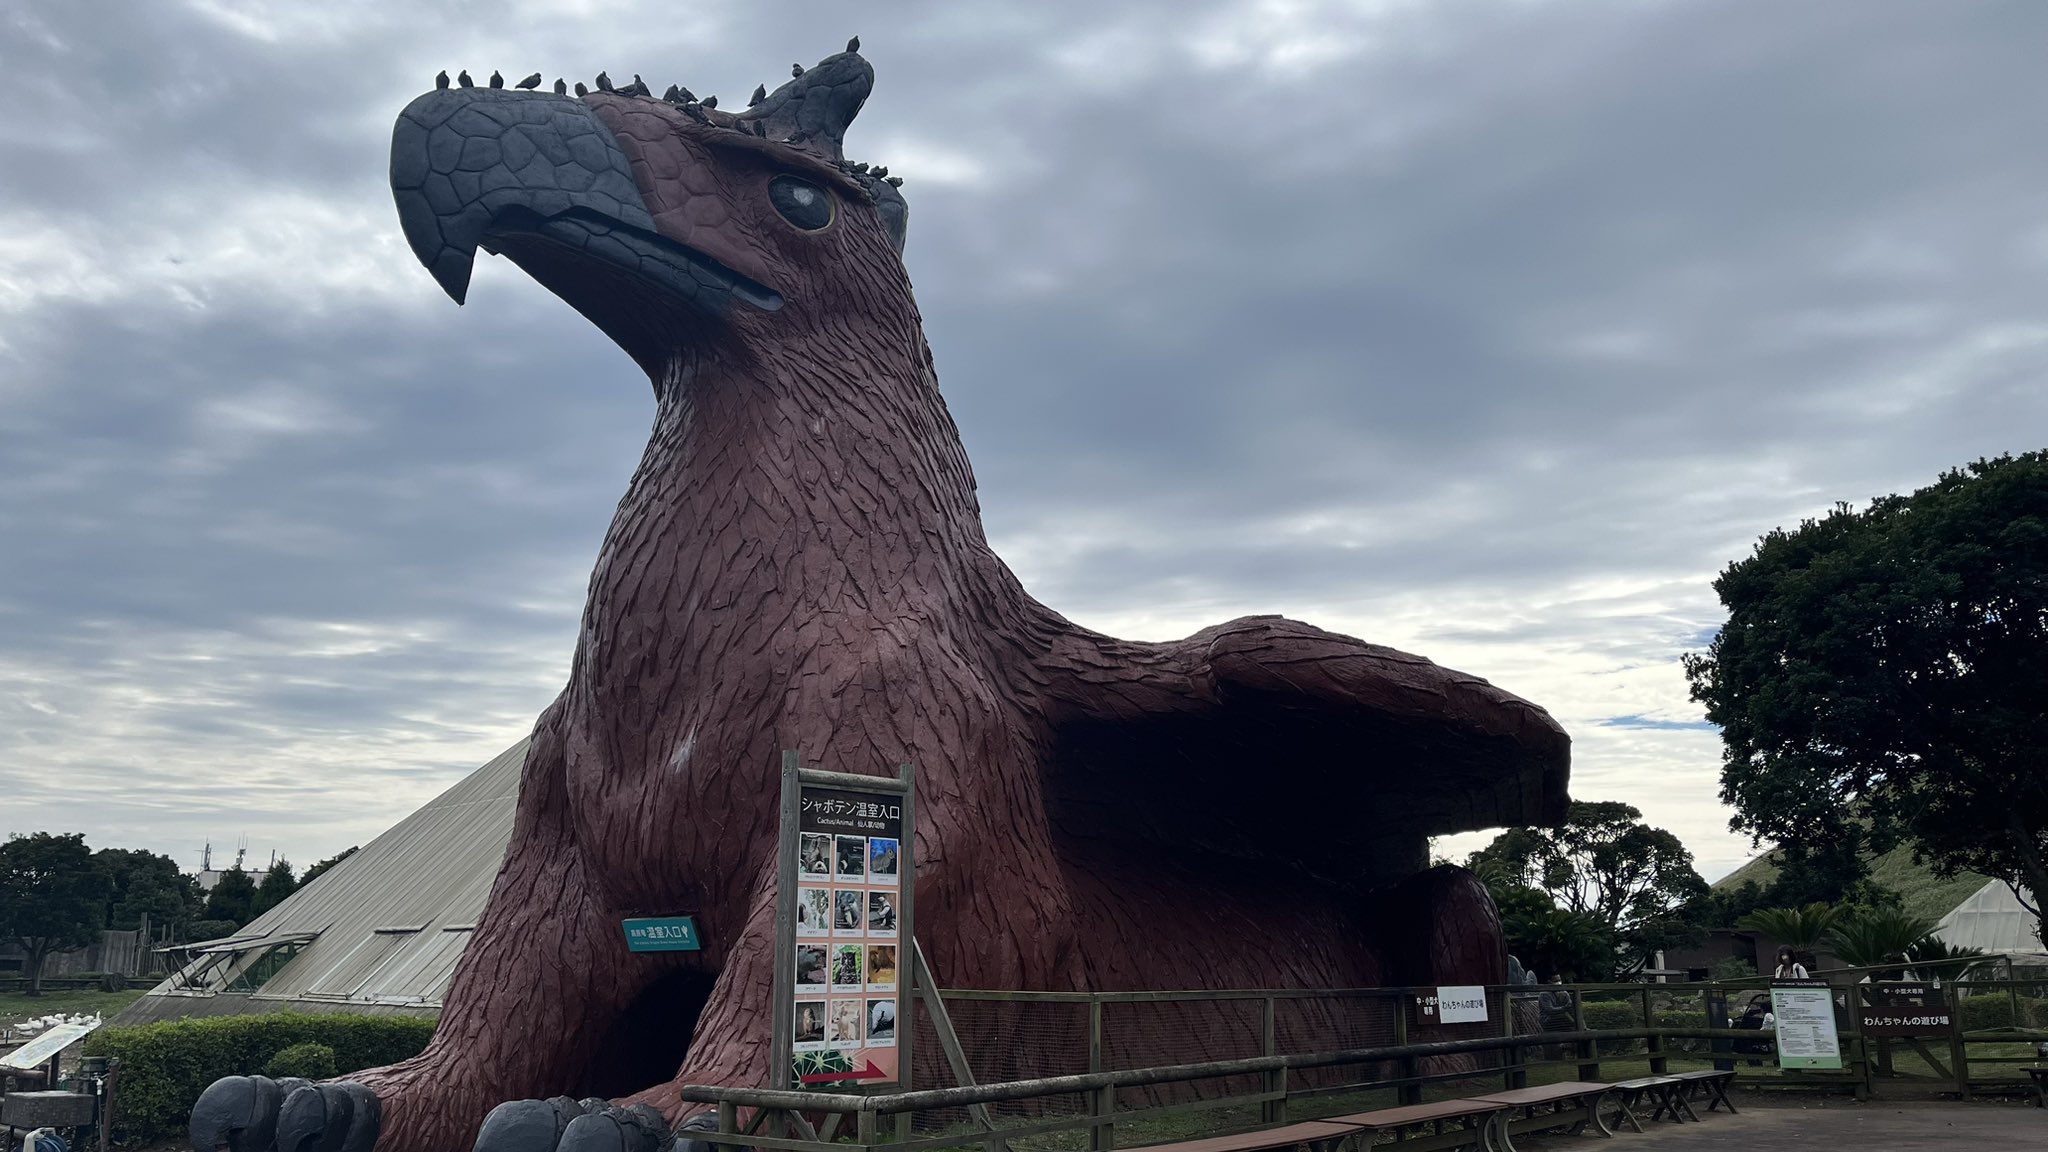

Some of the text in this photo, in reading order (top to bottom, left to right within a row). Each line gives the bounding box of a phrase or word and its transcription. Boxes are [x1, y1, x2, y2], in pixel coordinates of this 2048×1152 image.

[802, 797, 900, 820] シャボテン温室入口
[817, 816, 854, 826] Cactus/Animal
[1864, 1016, 1950, 1026] わんちゃんの遊び場
